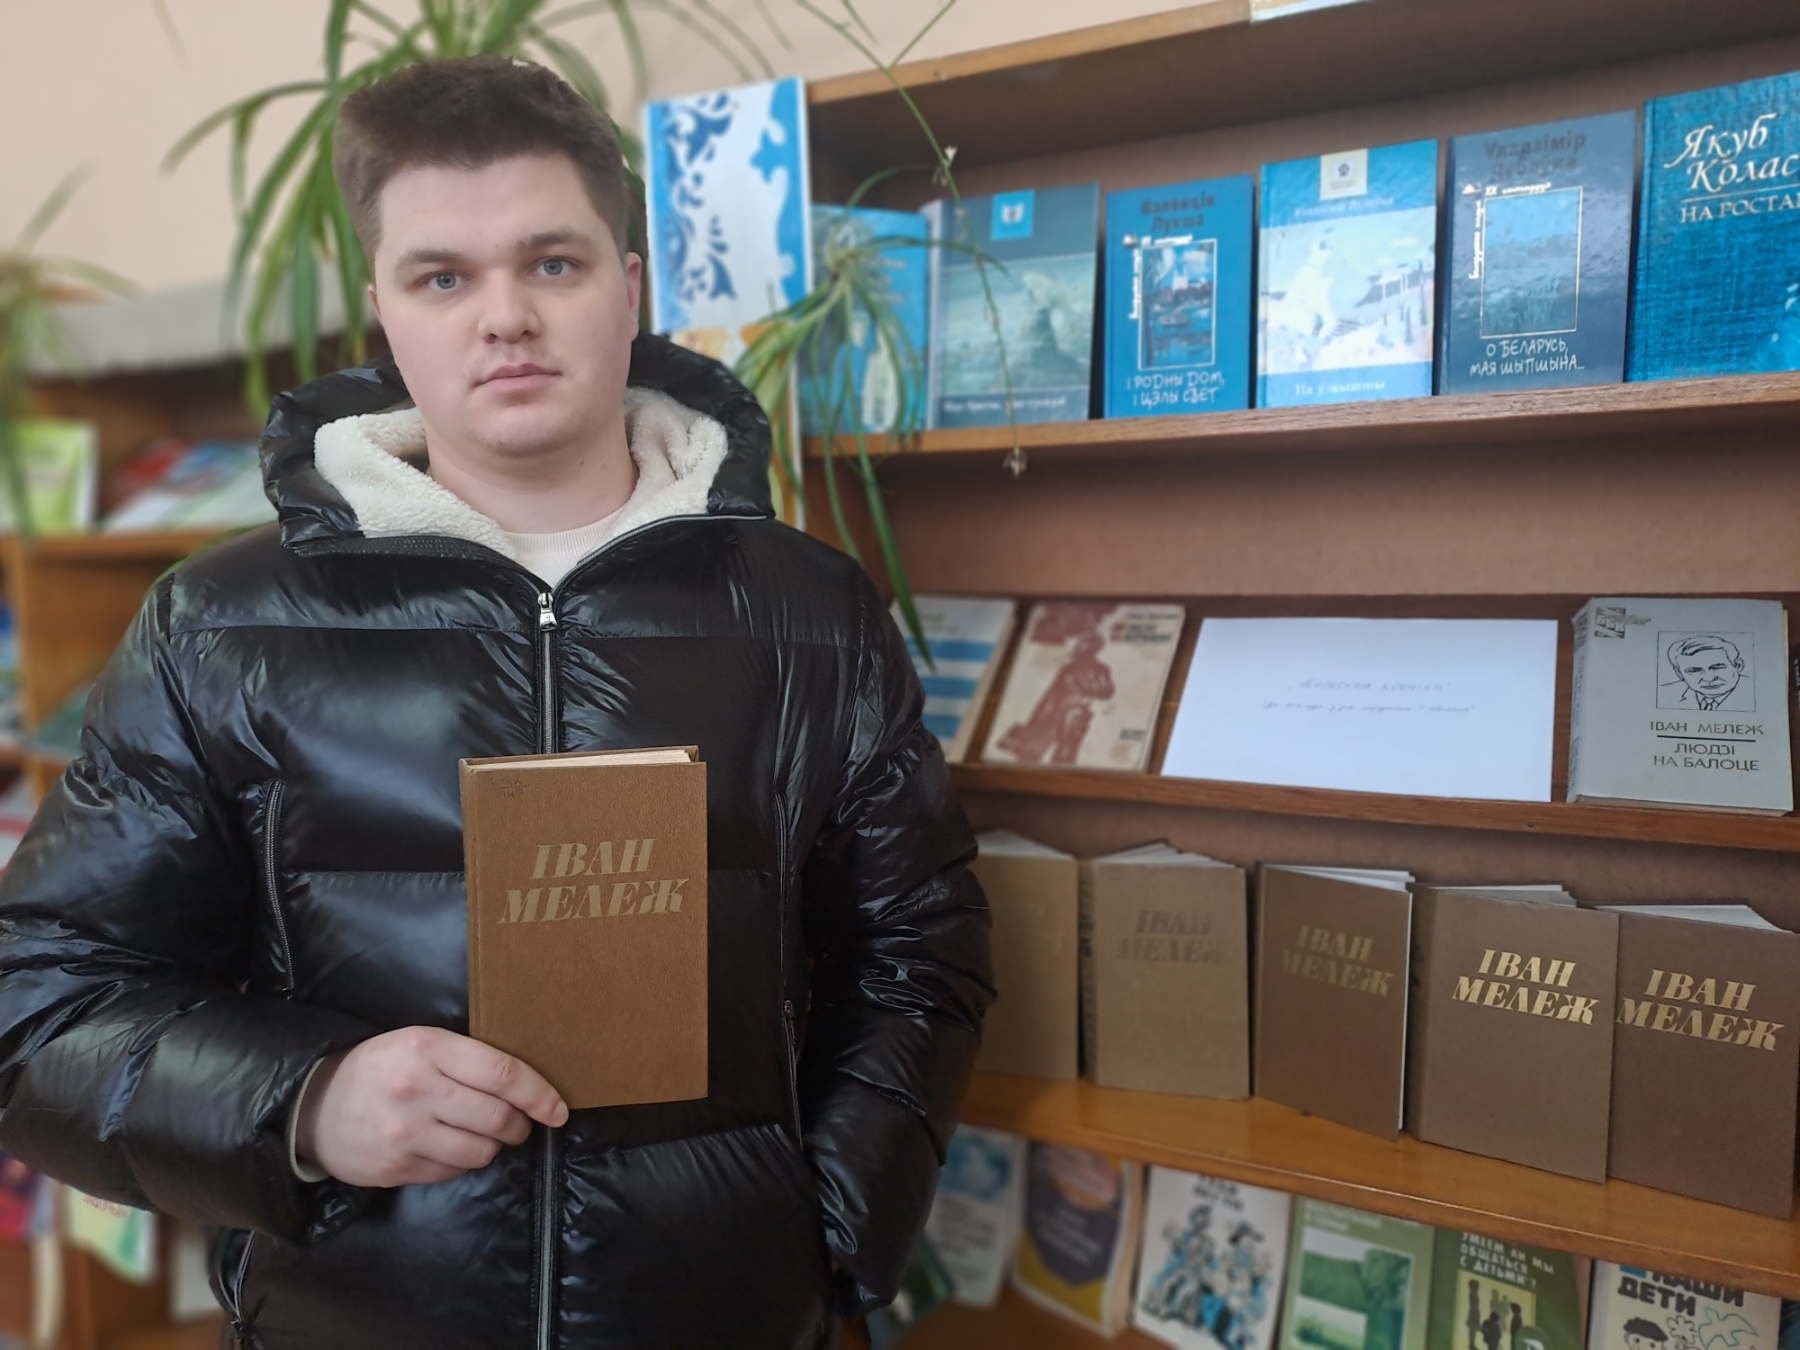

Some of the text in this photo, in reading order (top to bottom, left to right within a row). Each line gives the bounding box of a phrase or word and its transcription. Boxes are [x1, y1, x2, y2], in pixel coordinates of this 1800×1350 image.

[1484, 130, 1586, 160] Уладзімір
[1663, 112, 1777, 168] Якуб
[1686, 154, 1799, 193] Колас
[1151, 214, 1205, 235] Лукша
[1680, 206, 1713, 223] НА
[1141, 389, 1179, 410] ЦЭЛЫ
[1182, 386, 1219, 403] СВЕТ
[1650, 721, 1764, 735] ІВАН МЕЛЕЖ
[1654, 755, 1759, 772] НА БАЛОЦЕ
[1674, 743, 1735, 756] ЛЮДЗІ
[530, 838, 657, 879] ІВАН
[497, 879, 690, 924] МЕЛЕЖ
[1135, 910, 1214, 936] ІВАН
[1297, 924, 1374, 962] ІВАН
[1281, 949, 1395, 998] МЕЛЕЖ
[1478, 948, 1577, 988] ІВАН
[1452, 975, 1600, 1026] МЕЛЕЖ
[1644, 968, 1757, 1012] ІВАН
[1616, 997, 1786, 1051] МЕЛЕЖ
[1460, 1243, 1528, 1275] ОБЩАТЬСЯ
[1460, 1256, 1467, 1267] С
[1463, 1231, 1554, 1275] УМЕЕМ ЛИ МЫ
[1618, 1276, 1696, 1317] ДЕТИ
